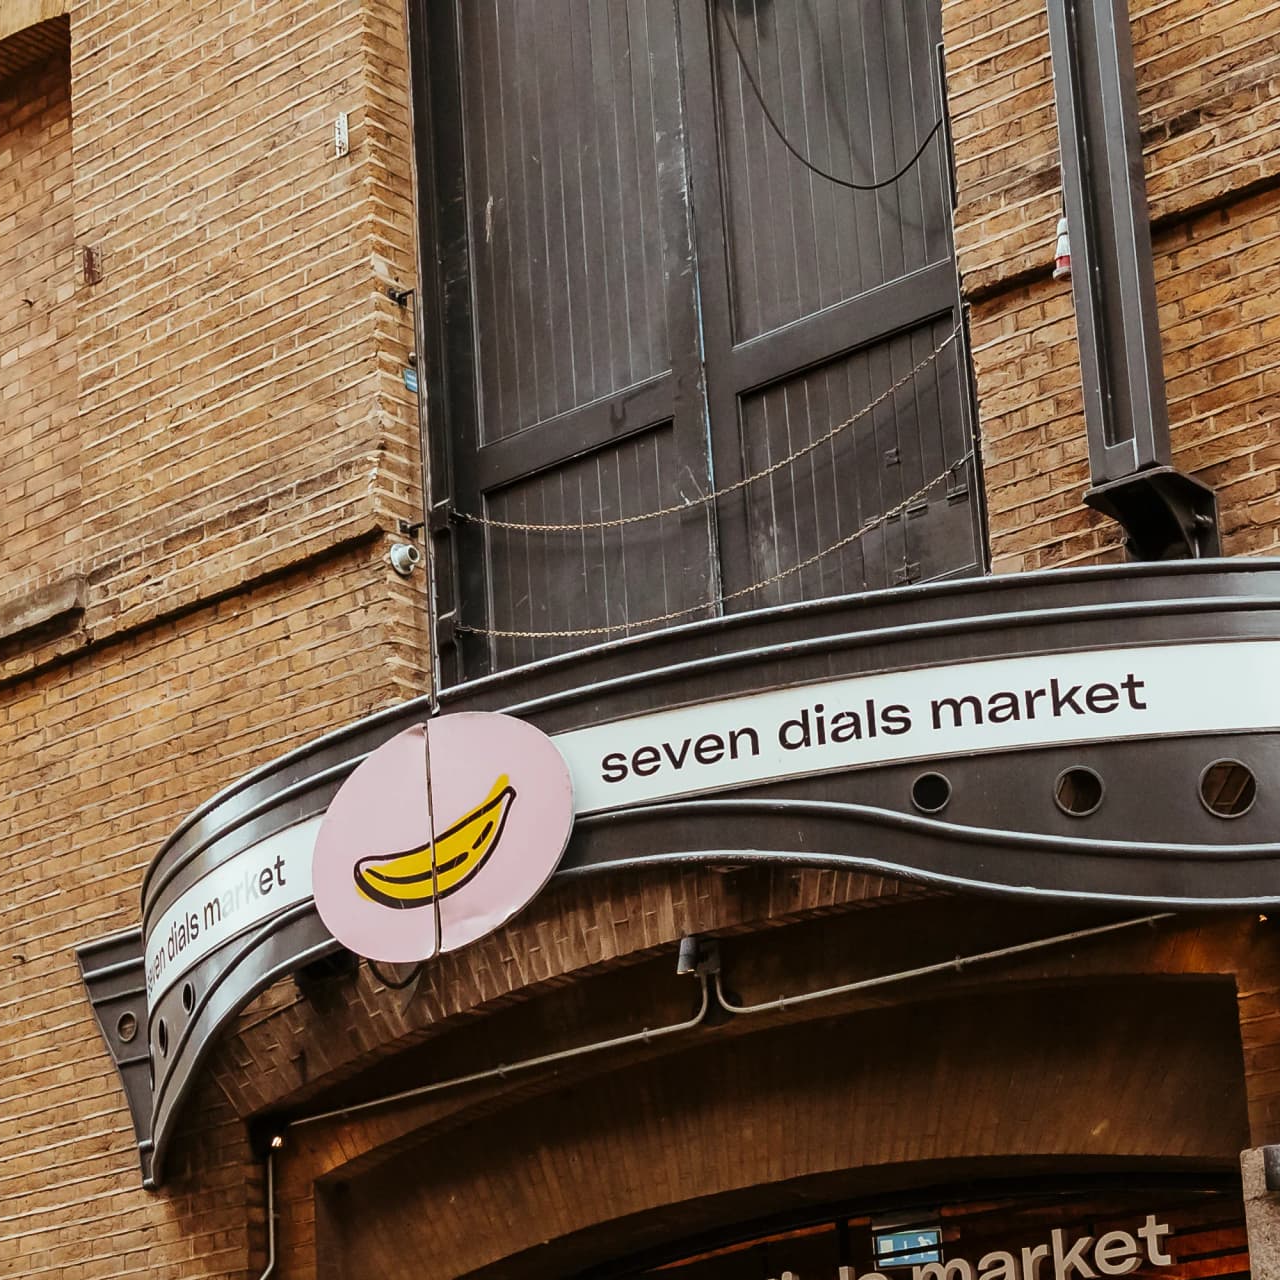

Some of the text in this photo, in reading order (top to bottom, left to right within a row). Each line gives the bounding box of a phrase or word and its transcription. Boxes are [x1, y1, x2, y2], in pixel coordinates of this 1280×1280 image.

[601, 672, 1148, 785] seven dials market
[167, 912, 199, 962] dials
[204, 855, 286, 930] market
